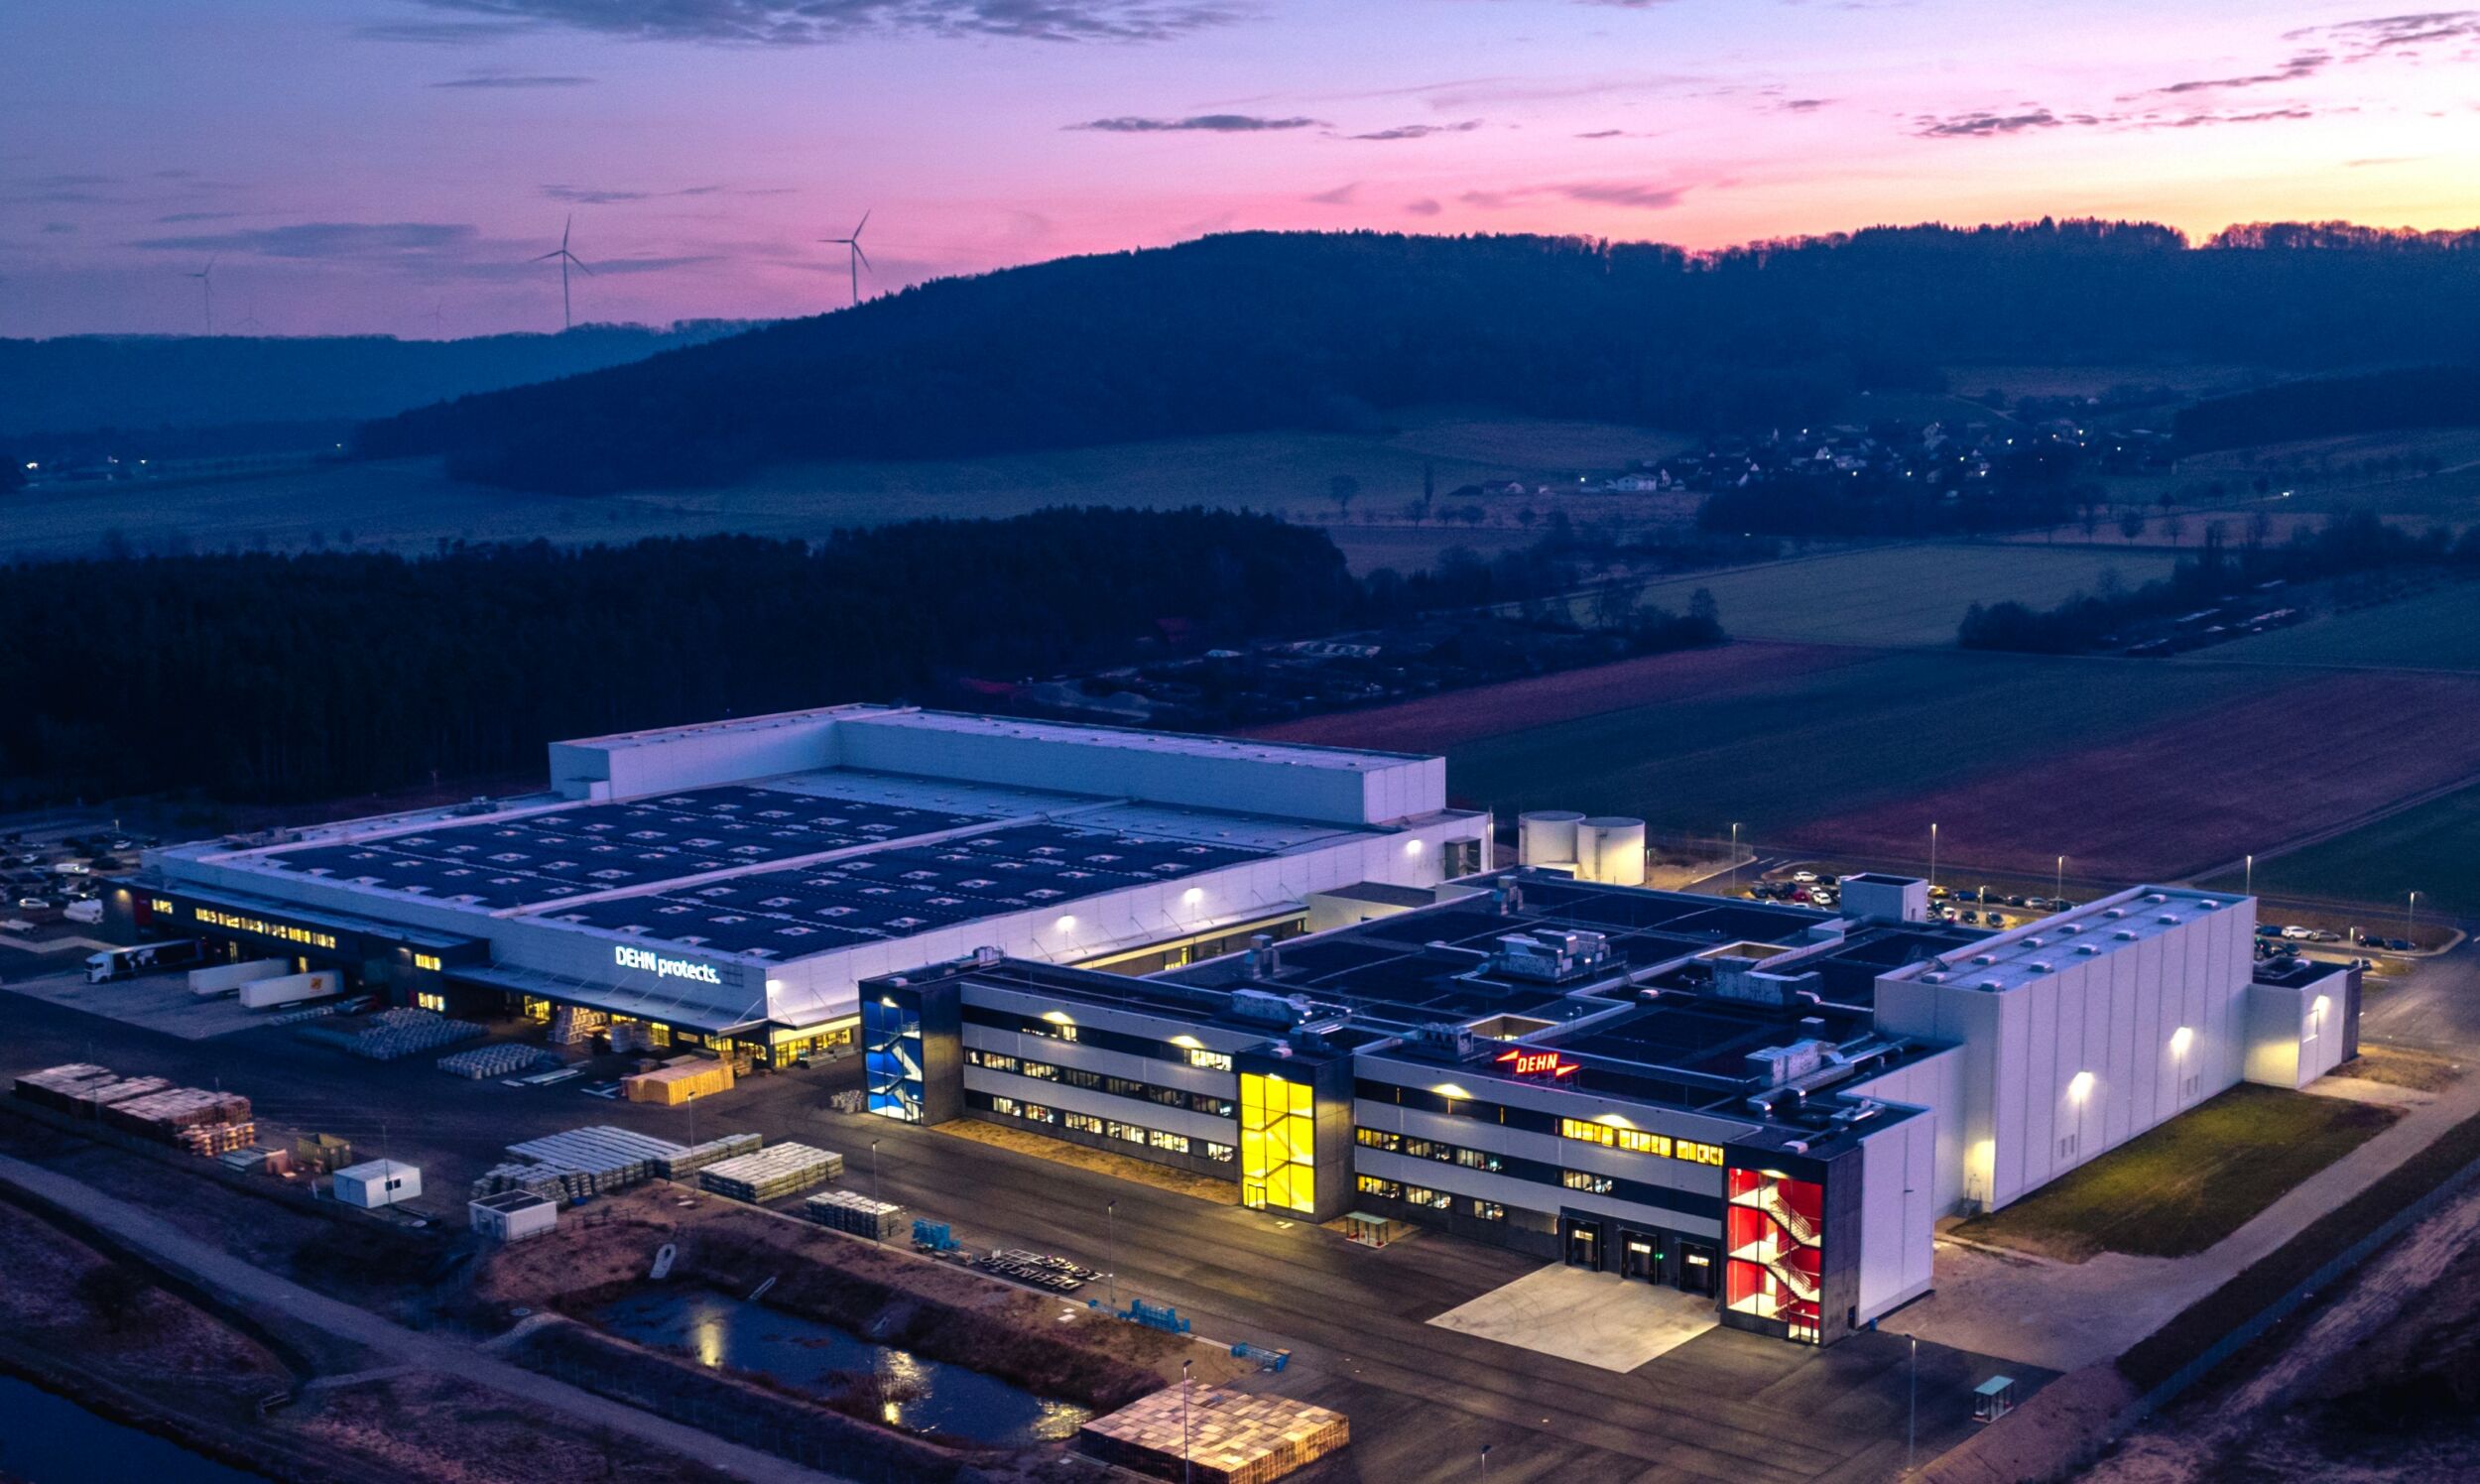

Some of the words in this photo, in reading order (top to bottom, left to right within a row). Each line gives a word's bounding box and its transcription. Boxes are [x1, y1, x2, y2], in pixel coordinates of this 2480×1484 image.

[615, 946, 657, 971] DEHN
[658, 958, 721, 984] protects.
[1517, 1053, 1557, 1072] DEHN
